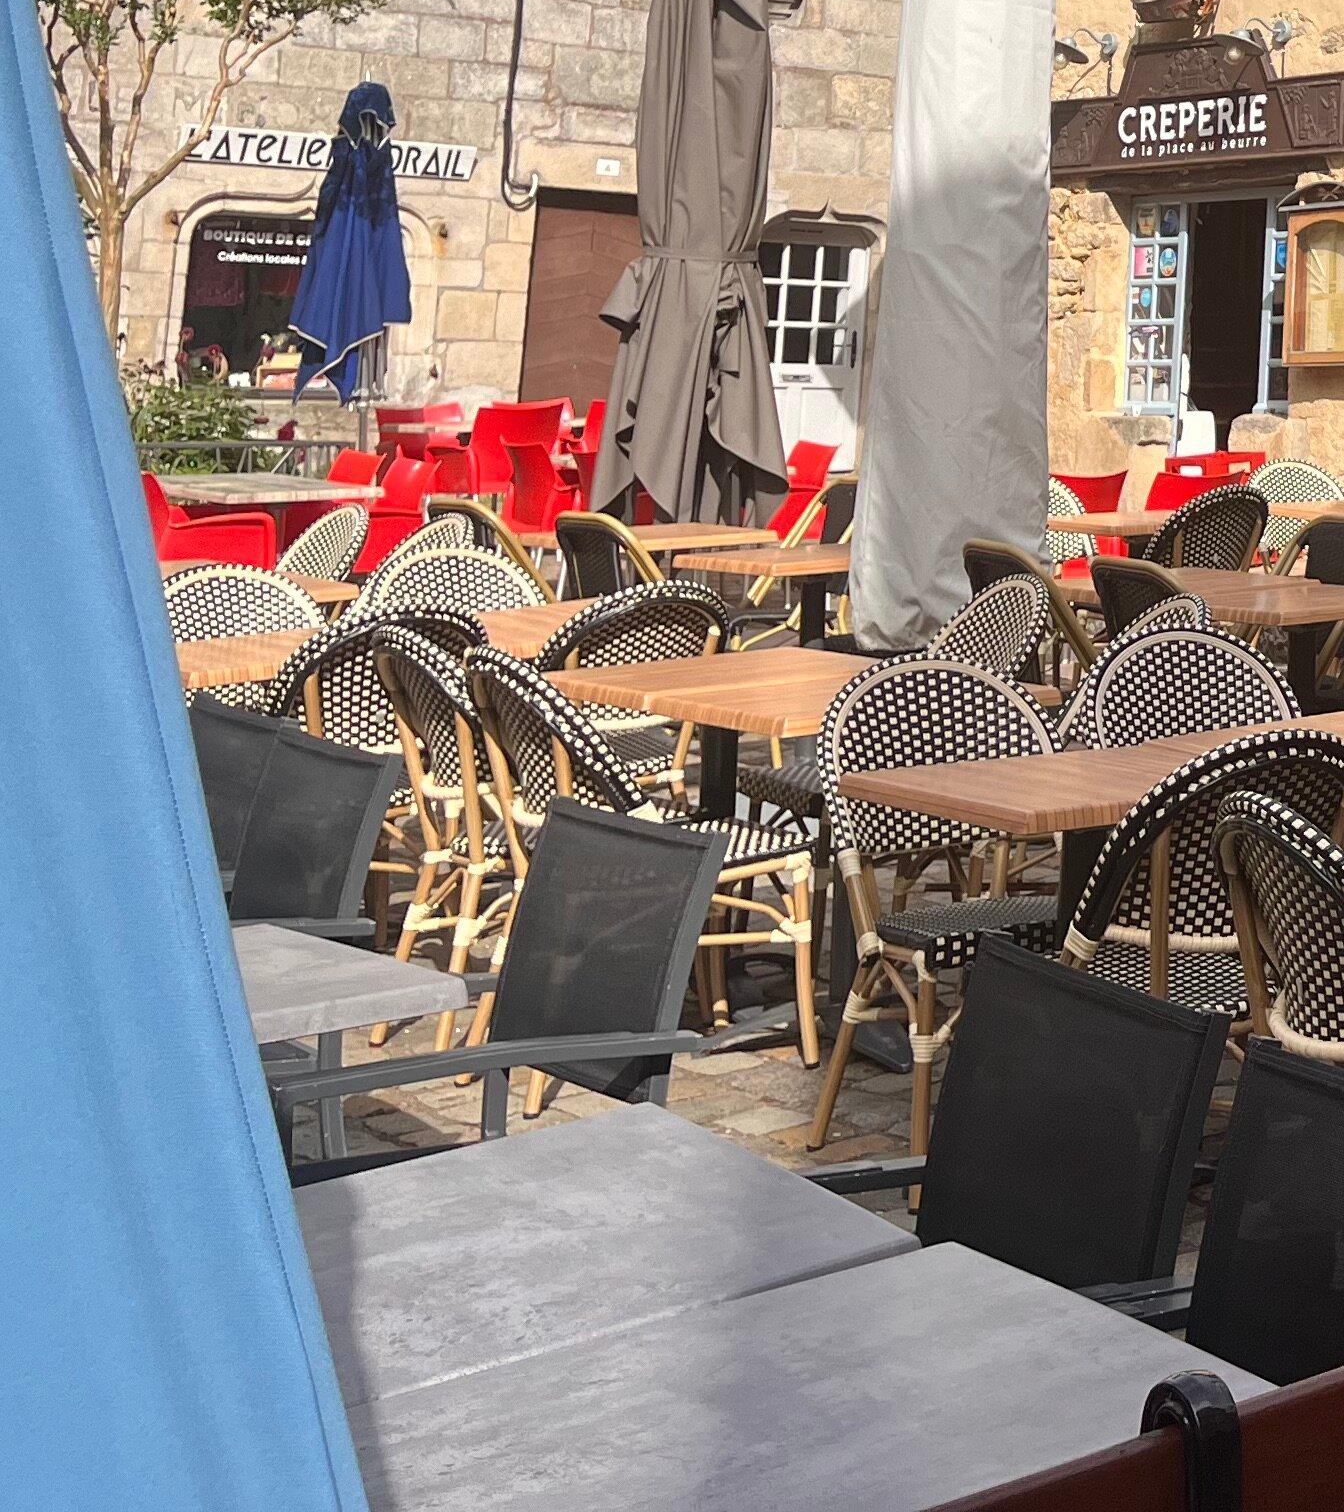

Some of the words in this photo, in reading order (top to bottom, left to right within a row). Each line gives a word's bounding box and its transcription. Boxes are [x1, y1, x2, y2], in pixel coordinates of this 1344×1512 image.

[1118, 94, 1268, 144] CREPERIE
[1121, 146, 1136, 158] de
[1141, 145, 1153, 157] la
[1158, 141, 1195, 157] place
[1201, 140, 1215, 152] au
[203, 229, 273, 245] BOUTIQUE
[275, 233, 294, 246] DE
